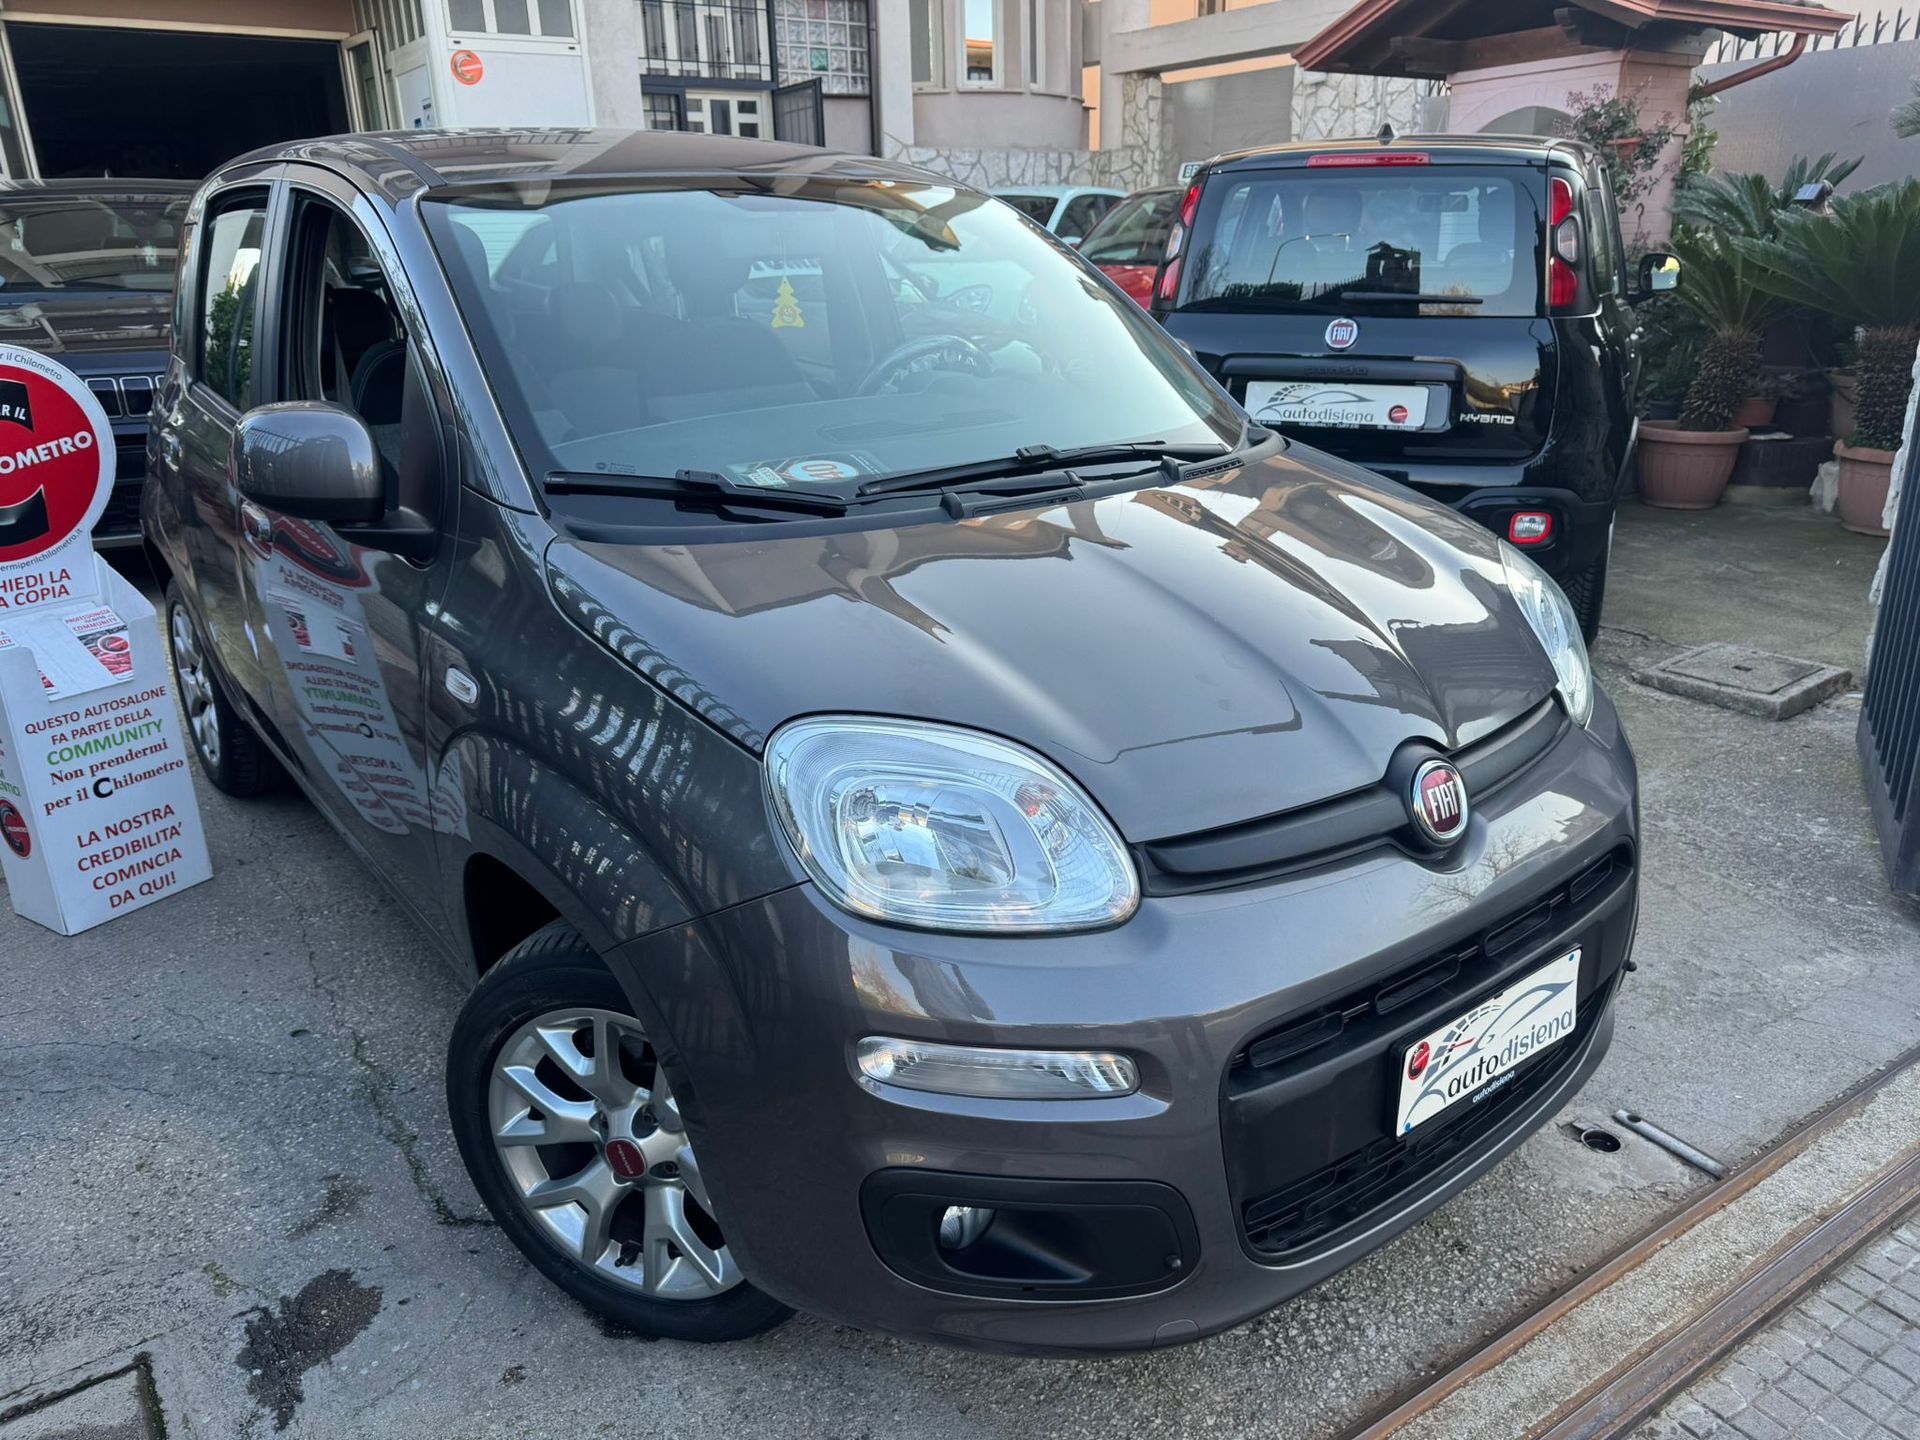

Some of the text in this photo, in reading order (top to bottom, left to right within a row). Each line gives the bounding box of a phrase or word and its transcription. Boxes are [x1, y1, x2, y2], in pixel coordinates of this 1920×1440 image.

[1332, 326, 1352, 341] FIAT
[6, 352, 13, 361] il
[14, 354, 63, 380] Chilometro
[14, 406, 26, 420] IL
[1282, 405, 1375, 423] autodisiena
[1459, 413, 1516, 425] HYBRID
[50, 568, 71, 584] LA
[14, 584, 70, 606] COPIA
[72, 617, 117, 632] COMMUNITY
[25, 686, 166, 735] QUESTO AUTOSALONE
[51, 708, 152, 746] FA PARTE DELLA
[47, 719, 163, 766] COMMUNITY
[50, 738, 169, 787] Non prendermi
[44, 760, 185, 816] per il Chilometro
[1427, 780, 1459, 822] FIAT
[77, 804, 175, 848] LA NOSTRA
[77, 822, 182, 872] CREDIBILITA'
[93, 848, 182, 891] COMINCIA
[109, 871, 177, 908] DA QUI!
[1447, 1008, 1573, 1098] autodisiena
[1473, 1070, 1515, 1104] autodisiena
